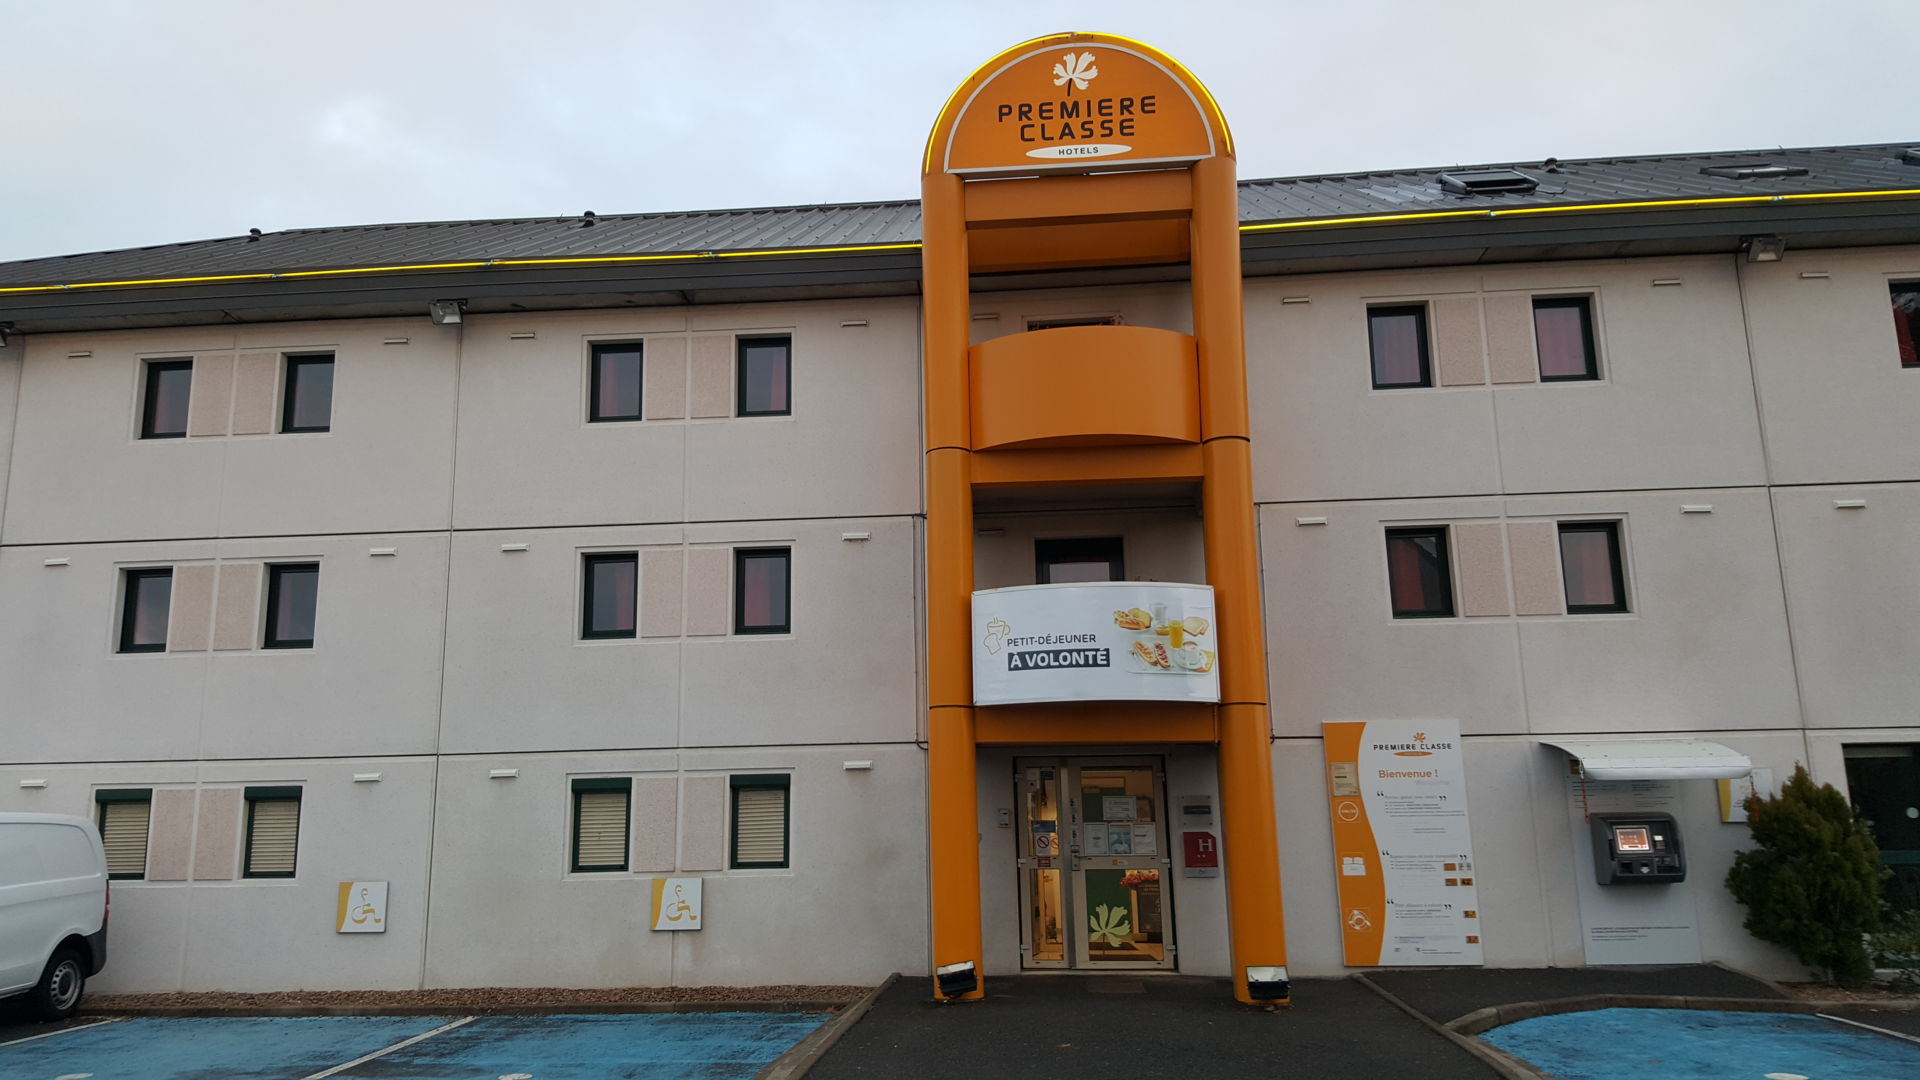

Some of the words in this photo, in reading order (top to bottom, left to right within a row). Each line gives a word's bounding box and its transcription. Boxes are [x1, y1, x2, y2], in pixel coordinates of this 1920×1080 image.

[998, 95, 1156, 122] PREMIERE
[1020, 118, 1135, 142] CLASSE
[1058, 146, 1099, 156] HOTELS
[1007, 633, 1096, 647] PETIT-DÉJEUNER
[1010, 650, 1022, 668] À
[1026, 648, 1107, 668] VOLONTÉ
[1373, 743, 1416, 751] PREMIERE
[1378, 769, 1432, 778] Bienvenue
[1197, 838, 1213, 852] H
